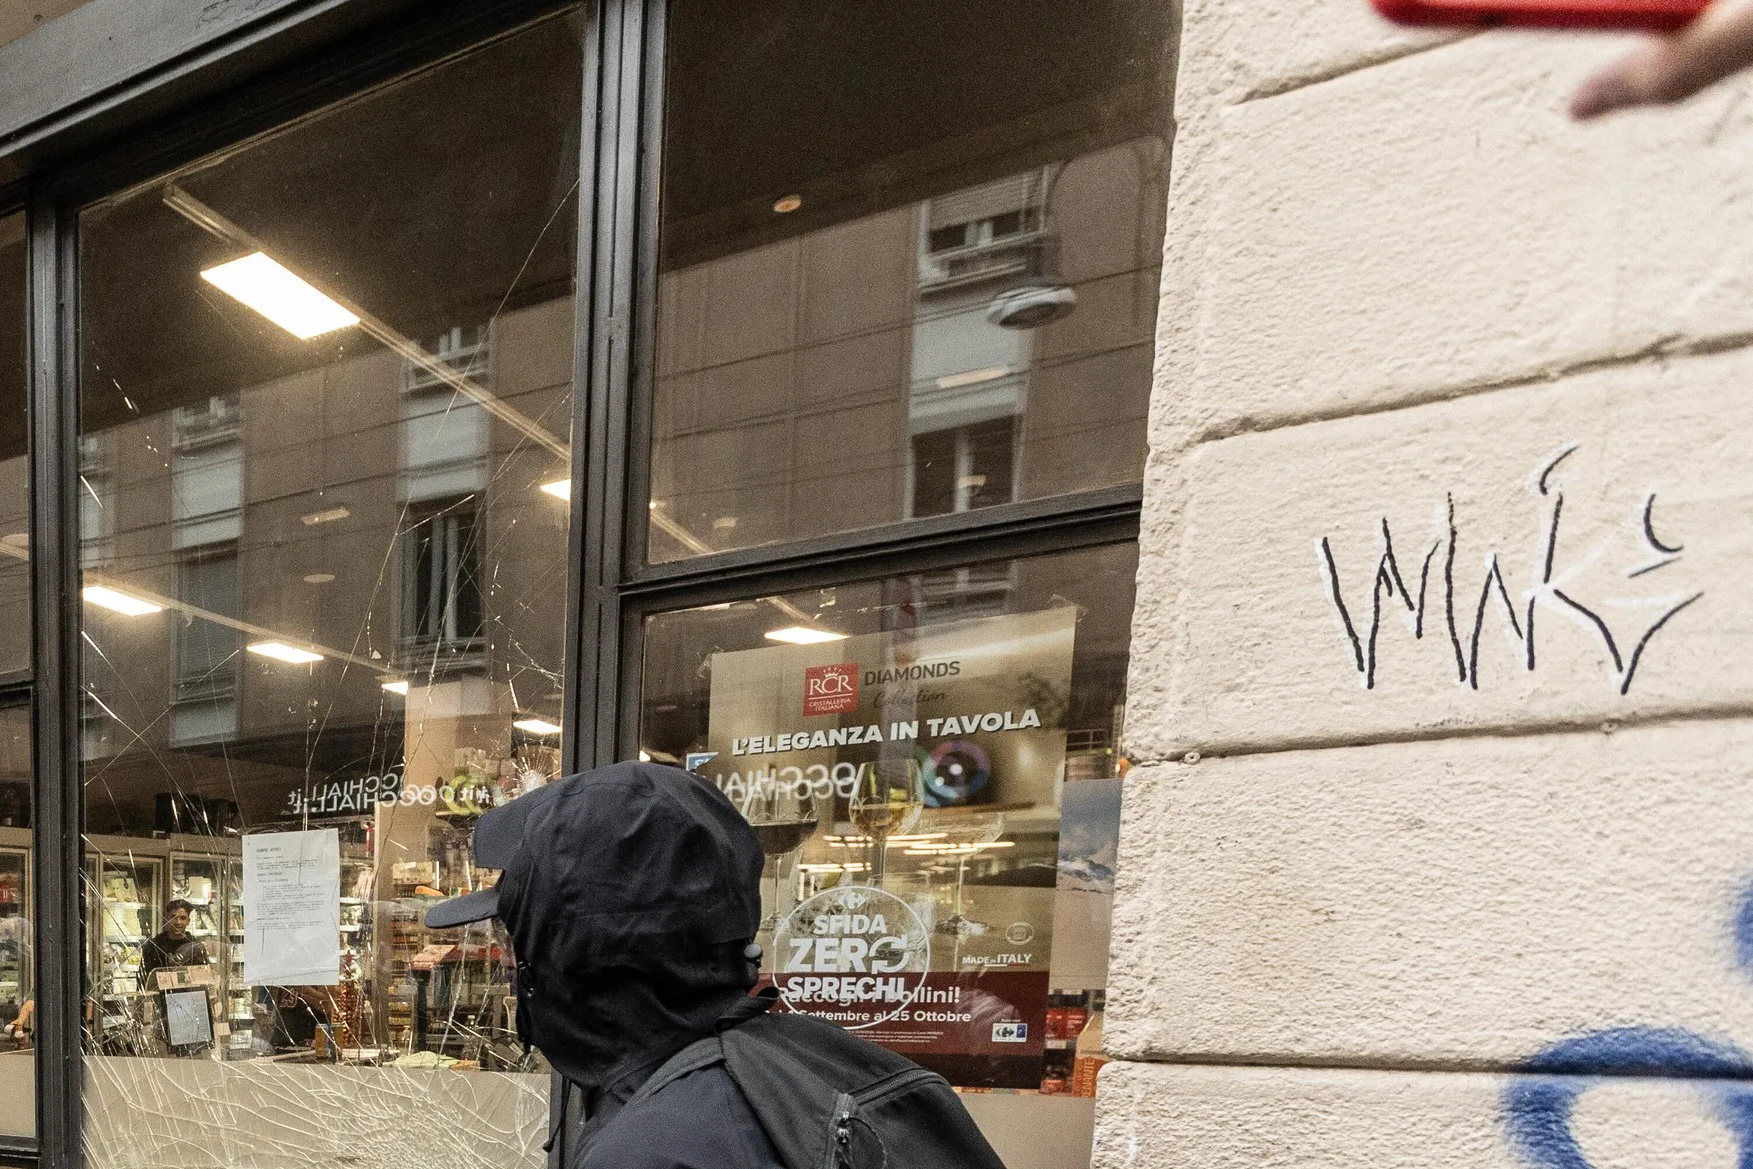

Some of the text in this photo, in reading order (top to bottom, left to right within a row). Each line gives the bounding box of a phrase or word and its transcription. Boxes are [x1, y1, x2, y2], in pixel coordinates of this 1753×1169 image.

[864, 661, 961, 686] DIAMONDS
[809, 674, 853, 696] RCR
[731, 709, 1042, 756] L'ELEGANZA IN TAVOLA
[813, 914, 887, 935] SFIDA
[962, 956, 990, 964] MADE
[997, 954, 1033, 964] ITALY
[787, 977, 906, 1000] SPRECHI
[890, 1010, 910, 1021] 25
[914, 1010, 972, 1022] Ottobre
